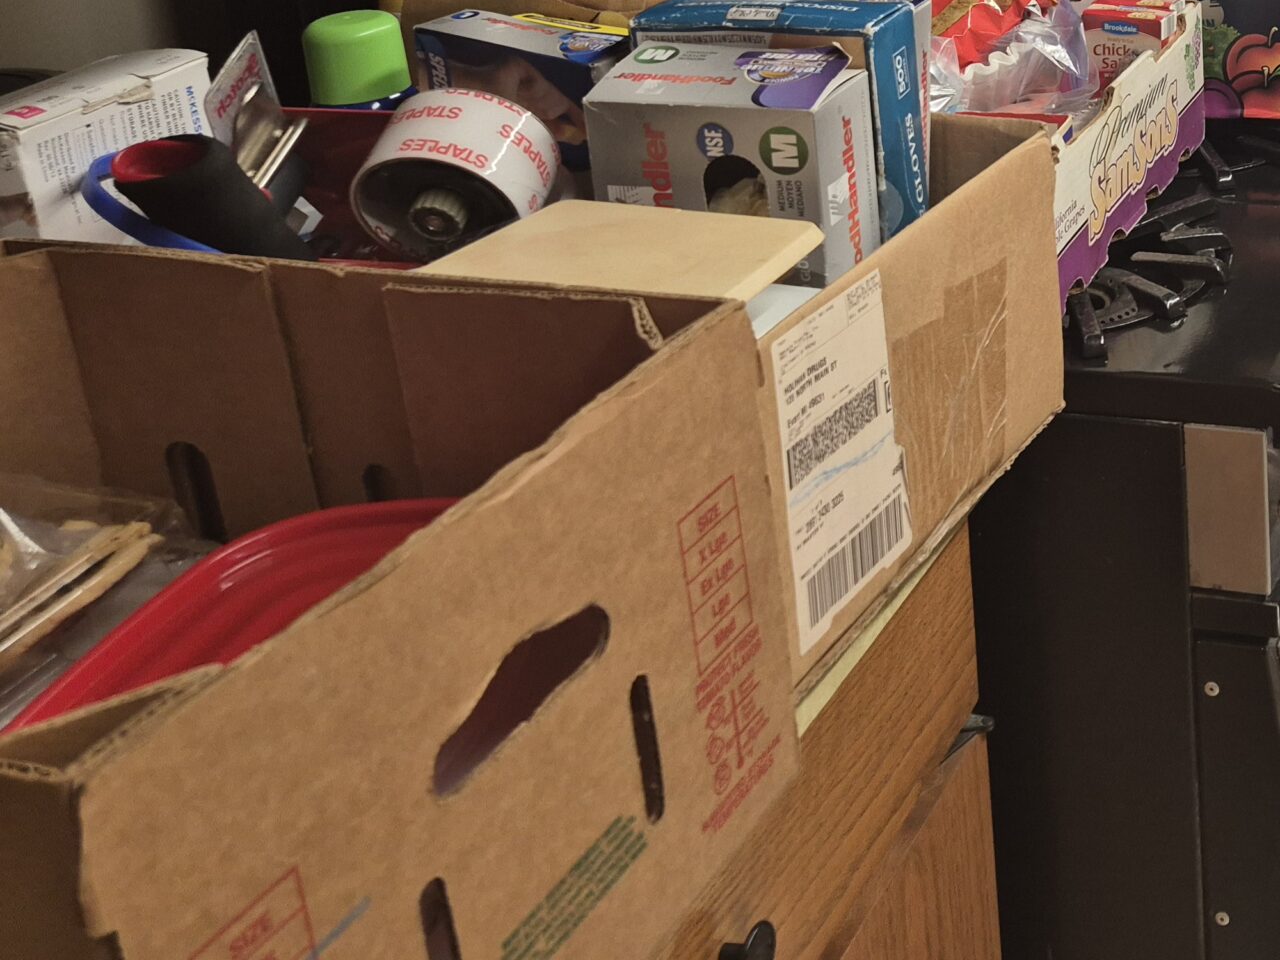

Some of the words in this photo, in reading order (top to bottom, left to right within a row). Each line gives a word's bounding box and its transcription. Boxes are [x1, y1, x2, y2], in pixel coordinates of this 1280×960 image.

[1104, 23, 1138, 33] Brookdale
[614, 70, 737, 86] FoodHandler
[895, 55, 906, 93] 500
[1102, 58, 1118, 69] Sa
[184, 85, 203, 134] McKESS
[1089, 73, 1169, 177] Premium
[399, 138, 489, 169] STAPLES
[499, 123, 550, 188] STAPLES
[704, 128, 724, 158] NSF
[769, 133, 800, 168] M
[905, 113, 924, 203] GLOVES
[641, 122, 675, 208] ndler
[778, 179, 786, 213] MEDIUM
[842, 116, 864, 265] odHandler
[1064, 205, 1086, 233] Grapes
[807, 356, 828, 376] DRUGS
[796, 380, 813, 398] NORTH
[697, 502, 721, 533] SIZE
[229, 908, 273, 959] SIZE
